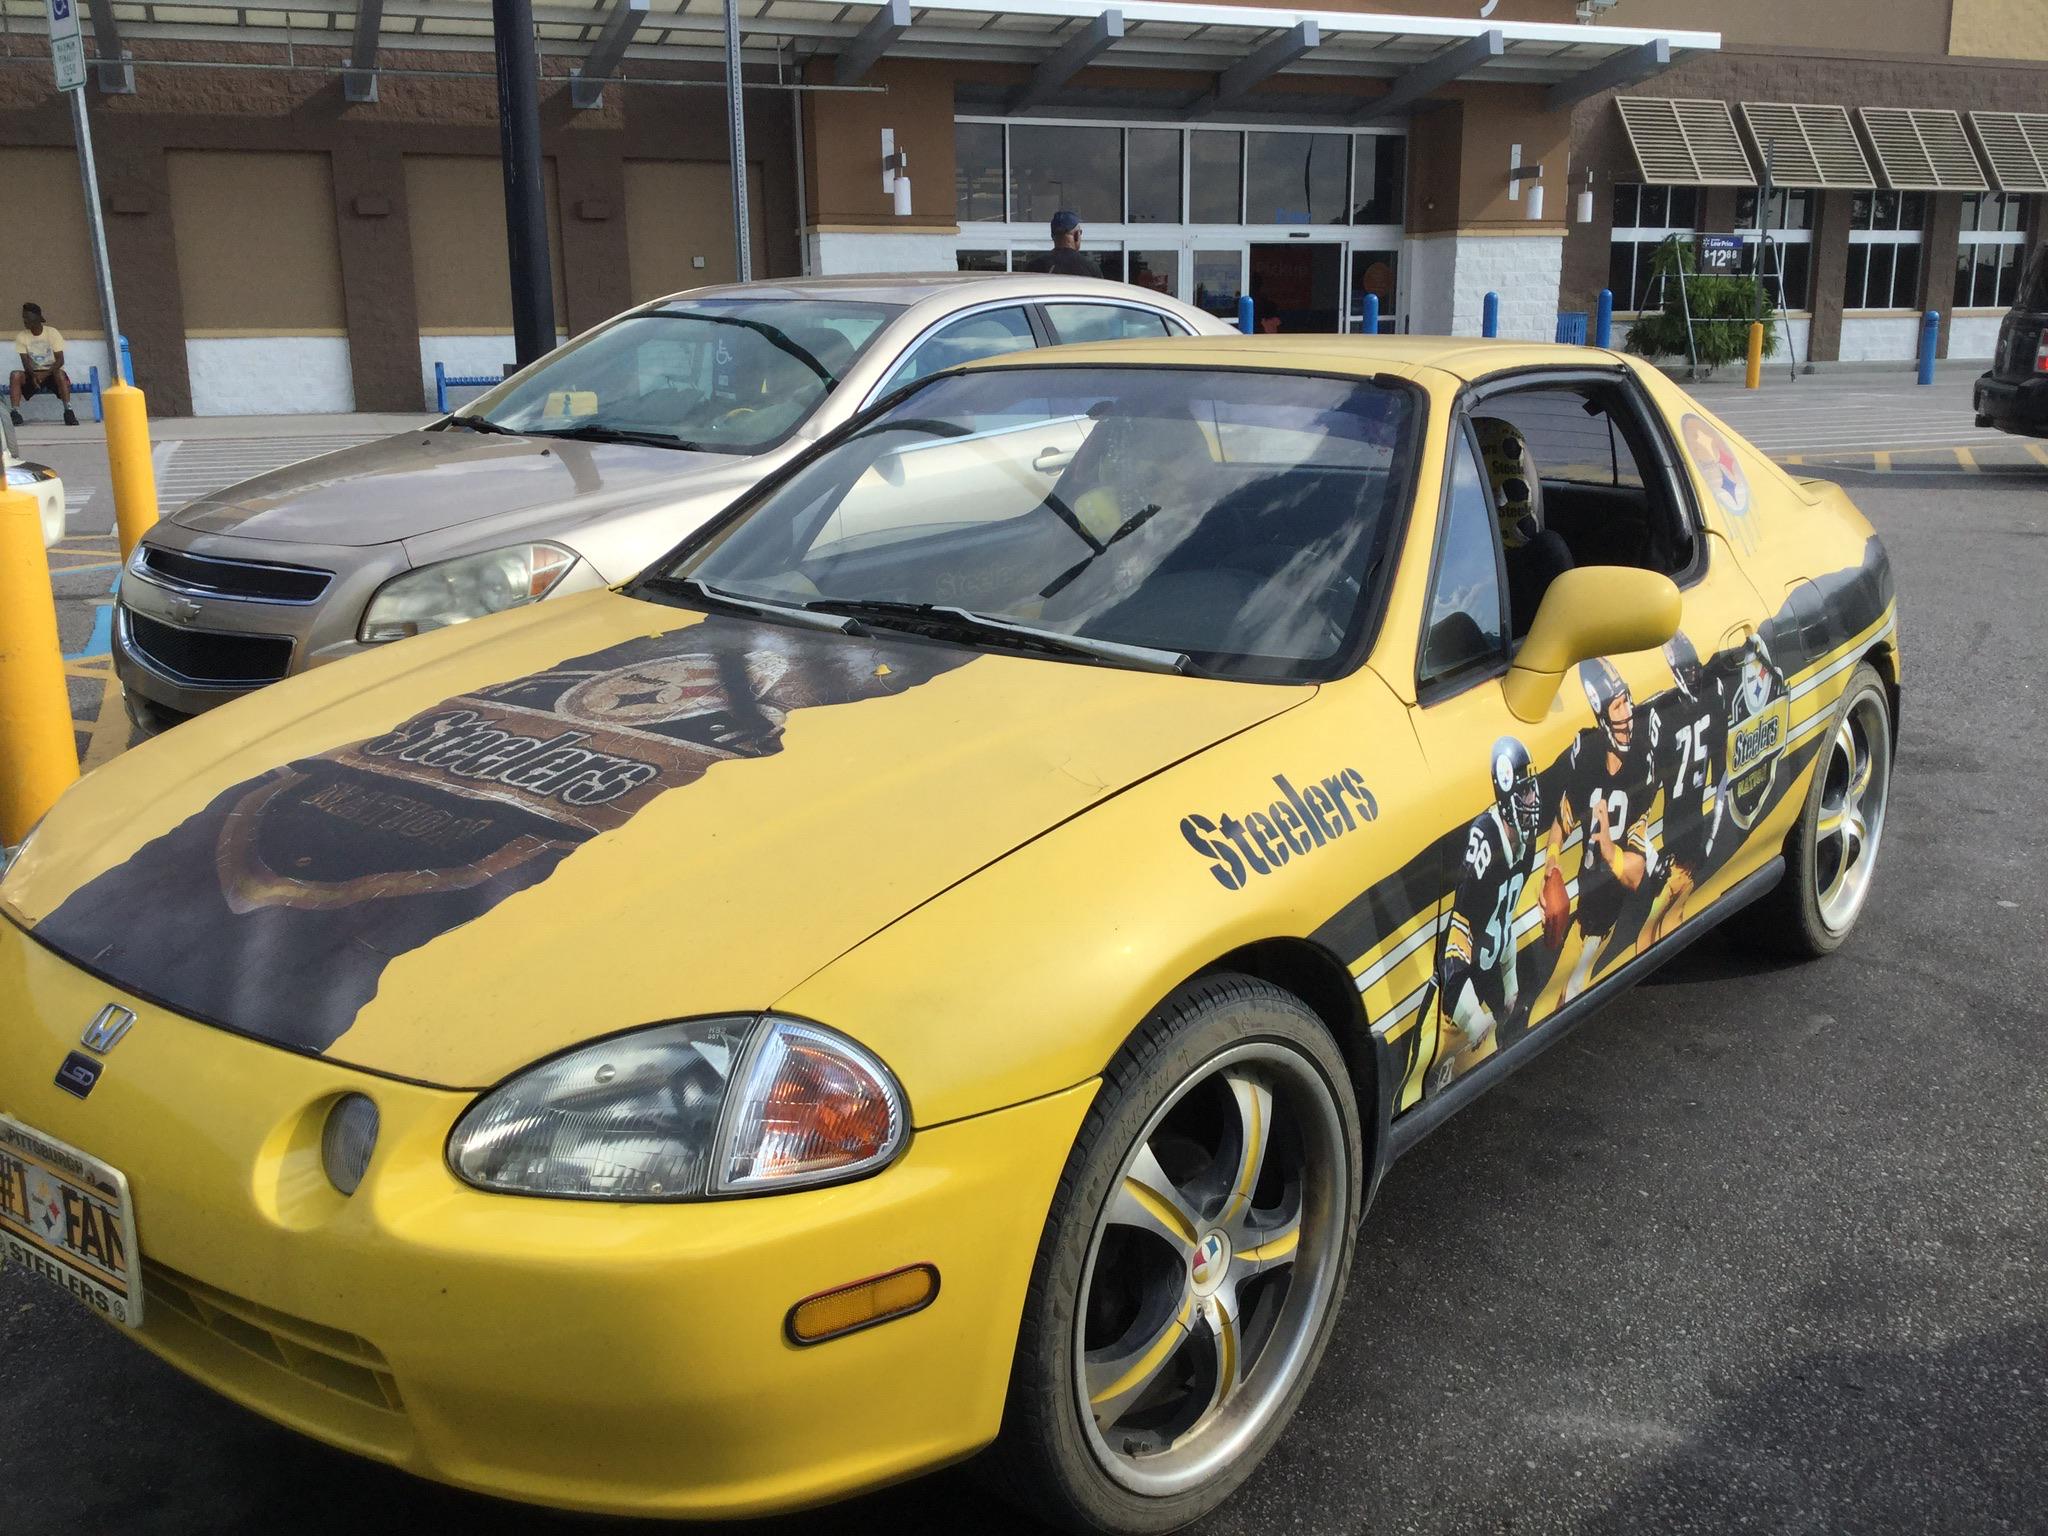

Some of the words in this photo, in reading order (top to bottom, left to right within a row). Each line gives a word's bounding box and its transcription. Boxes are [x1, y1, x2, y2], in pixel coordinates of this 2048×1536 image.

[363, 708, 658, 806] Steelers
[1672, 713, 1711, 800] 75
[1731, 716, 1780, 772] Steelers
[1179, 767, 1379, 891] Steelers
[1465, 826, 1492, 880] 58
[8, 1128, 84, 1175] PITTSBURGH
[57, 1184, 126, 1273] FAN
[9, 1239, 110, 1313] STEELERS
